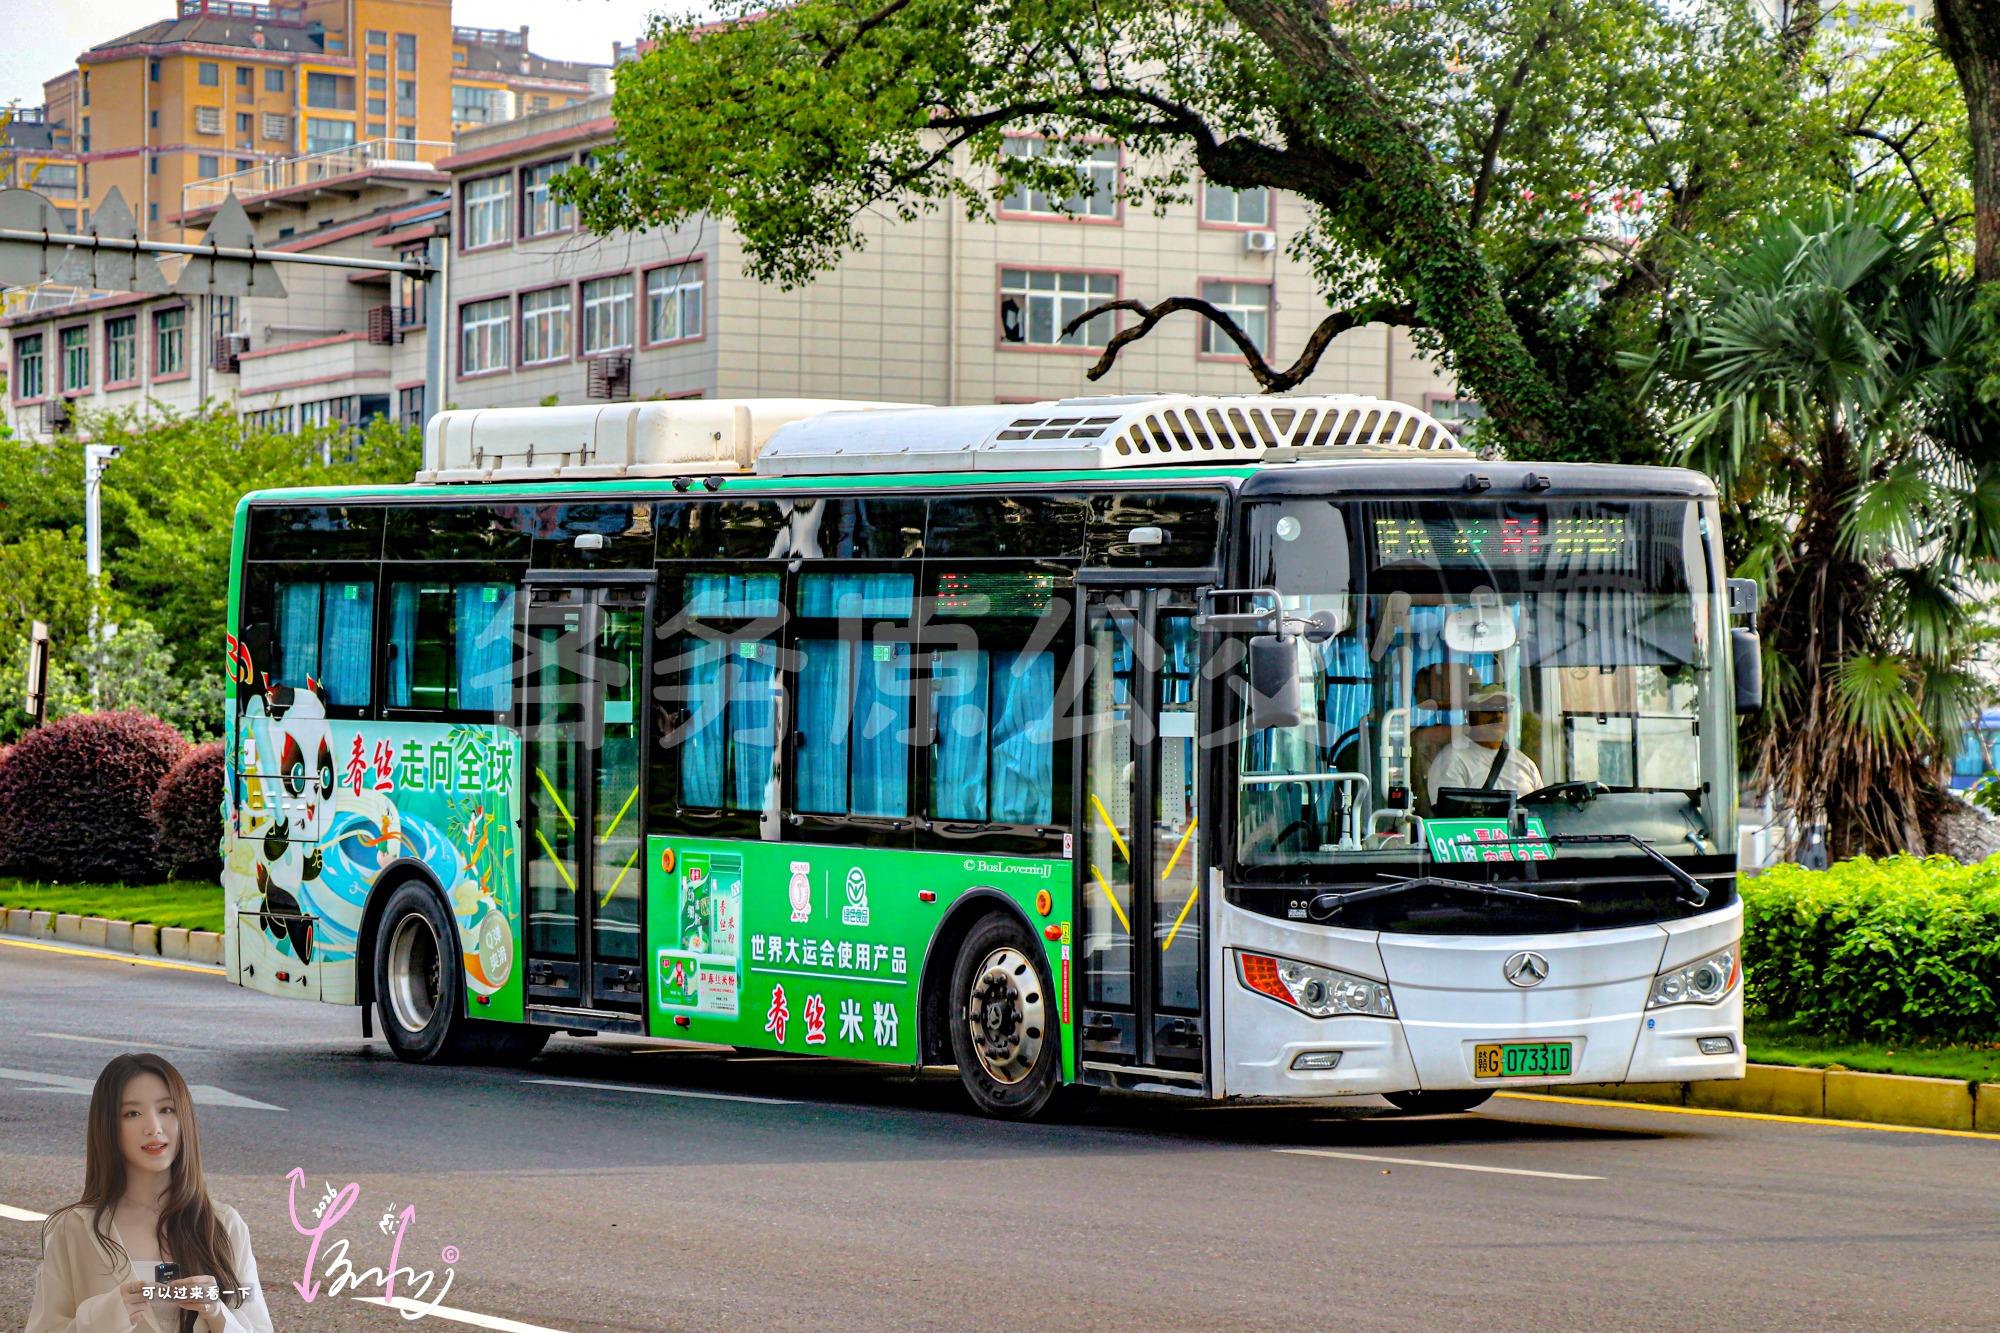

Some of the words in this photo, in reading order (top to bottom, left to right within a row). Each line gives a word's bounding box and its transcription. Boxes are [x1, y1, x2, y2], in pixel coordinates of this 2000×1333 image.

[750, 933, 908, 974] 世界大运会使用产品
